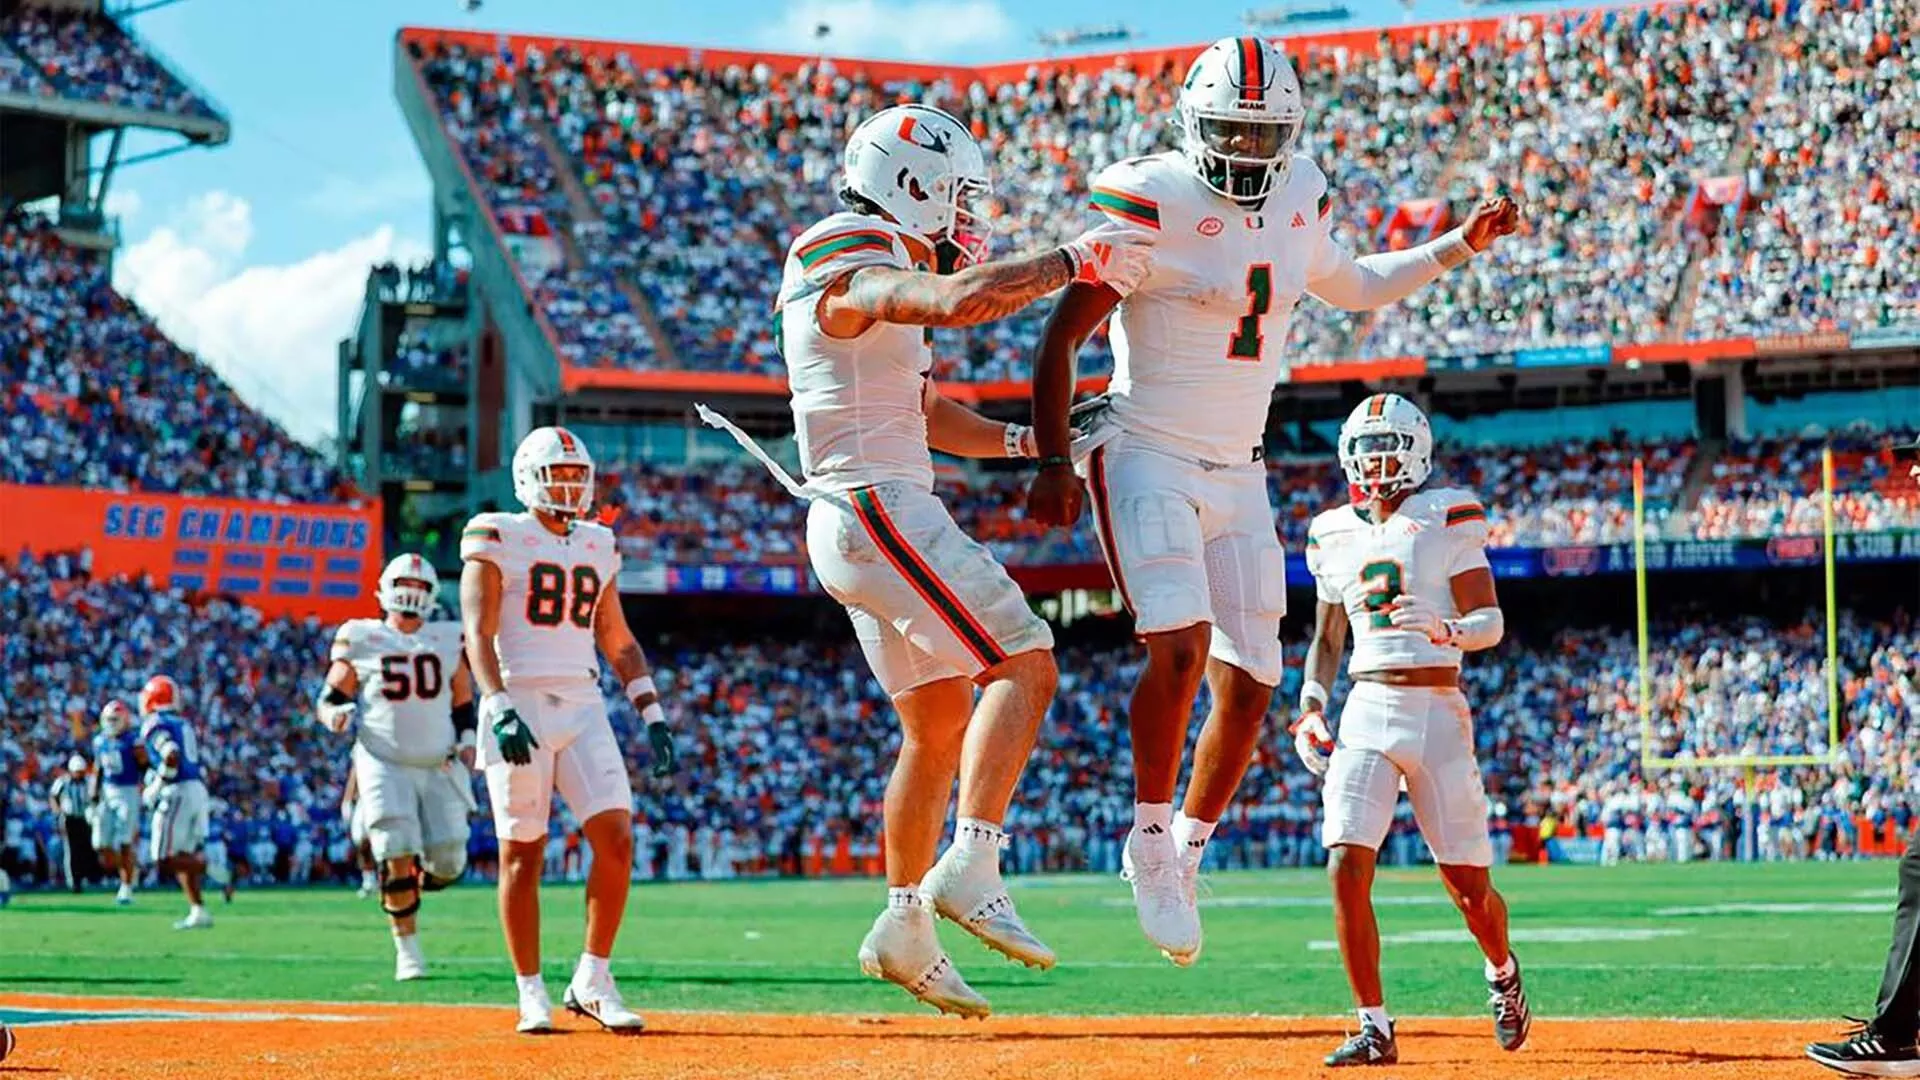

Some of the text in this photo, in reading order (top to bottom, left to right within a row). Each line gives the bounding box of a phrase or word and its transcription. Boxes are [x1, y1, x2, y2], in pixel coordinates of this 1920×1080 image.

[1237, 102, 1267, 111] MIAMI
[1227, 262, 1273, 362] 1
[104, 502, 370, 550] SEC CHAMPIONS
[525, 560, 602, 629] 88
[1359, 557, 1407, 630] 2
[381, 653, 443, 702] 50
